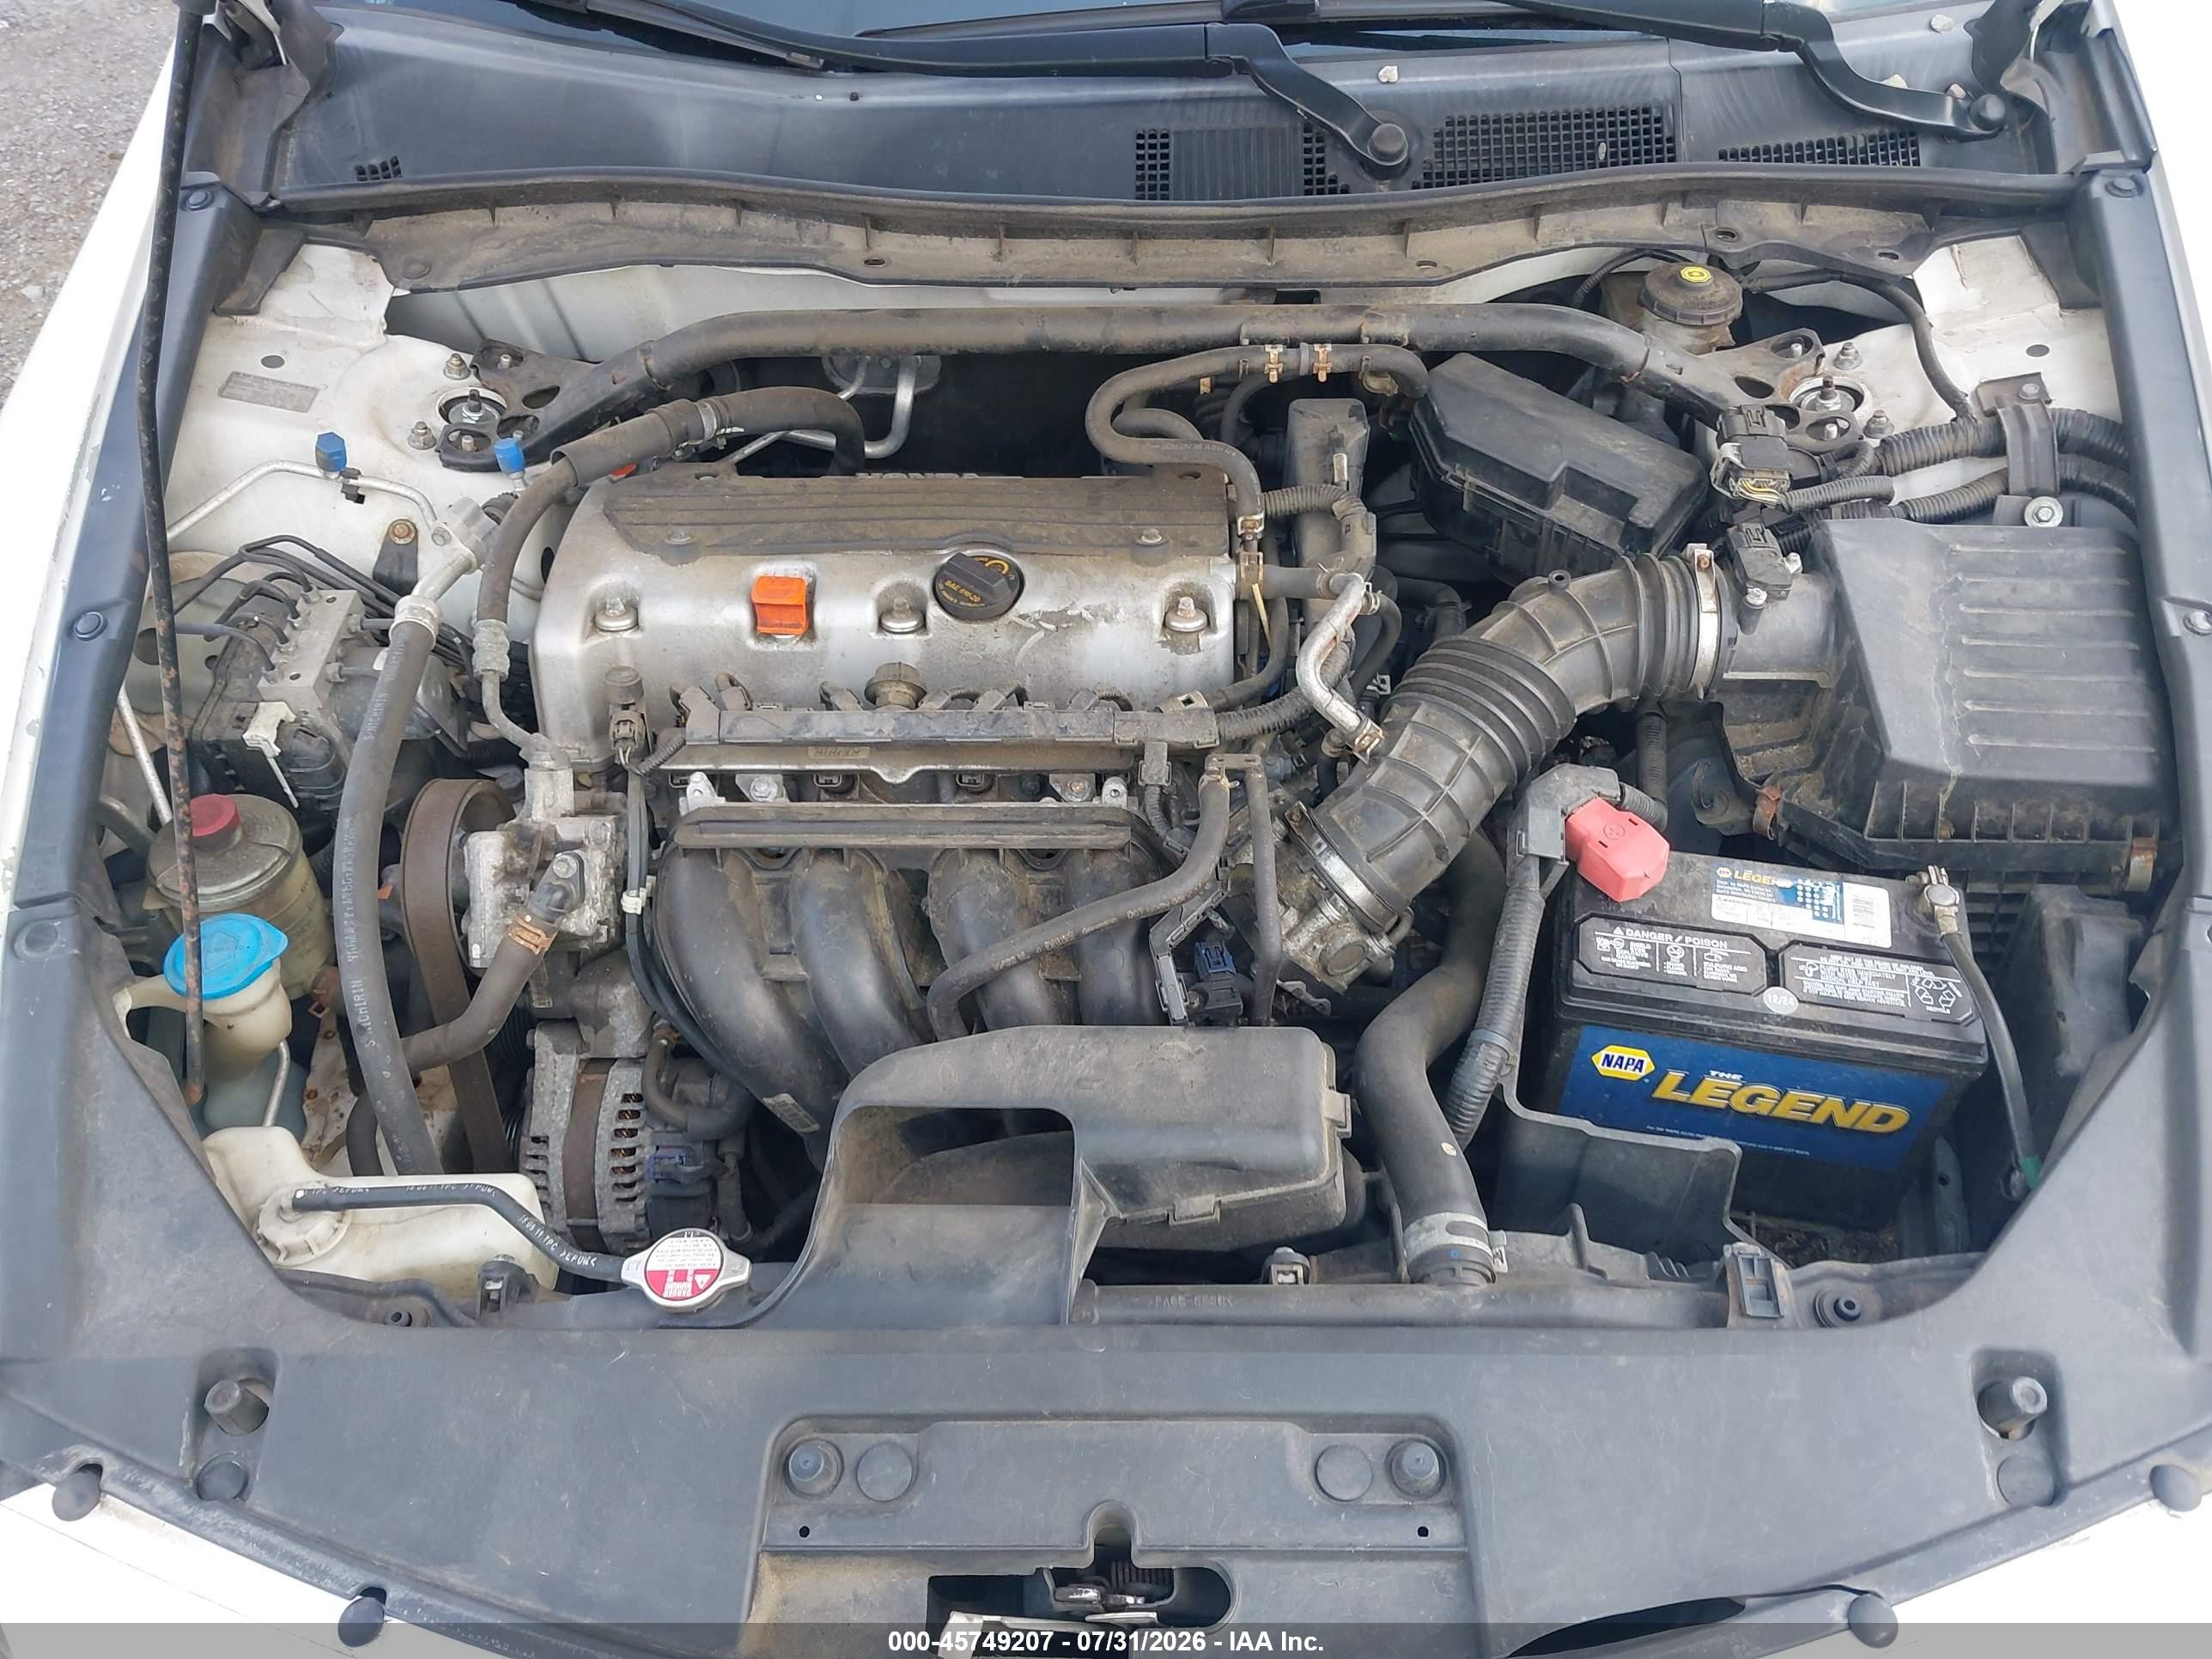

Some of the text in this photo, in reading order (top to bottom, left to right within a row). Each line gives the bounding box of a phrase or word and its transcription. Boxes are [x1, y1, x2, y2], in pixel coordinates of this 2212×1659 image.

[1626, 927, 1674, 943] DANGER
[1684, 935, 1729, 951] POISON
[1765, 993, 1795, 1006] 12/24
[1601, 1053, 1645, 1074] NAPA
[1709, 1069, 1744, 1081] THE
[1651, 1068, 1911, 1133] LEGEND
